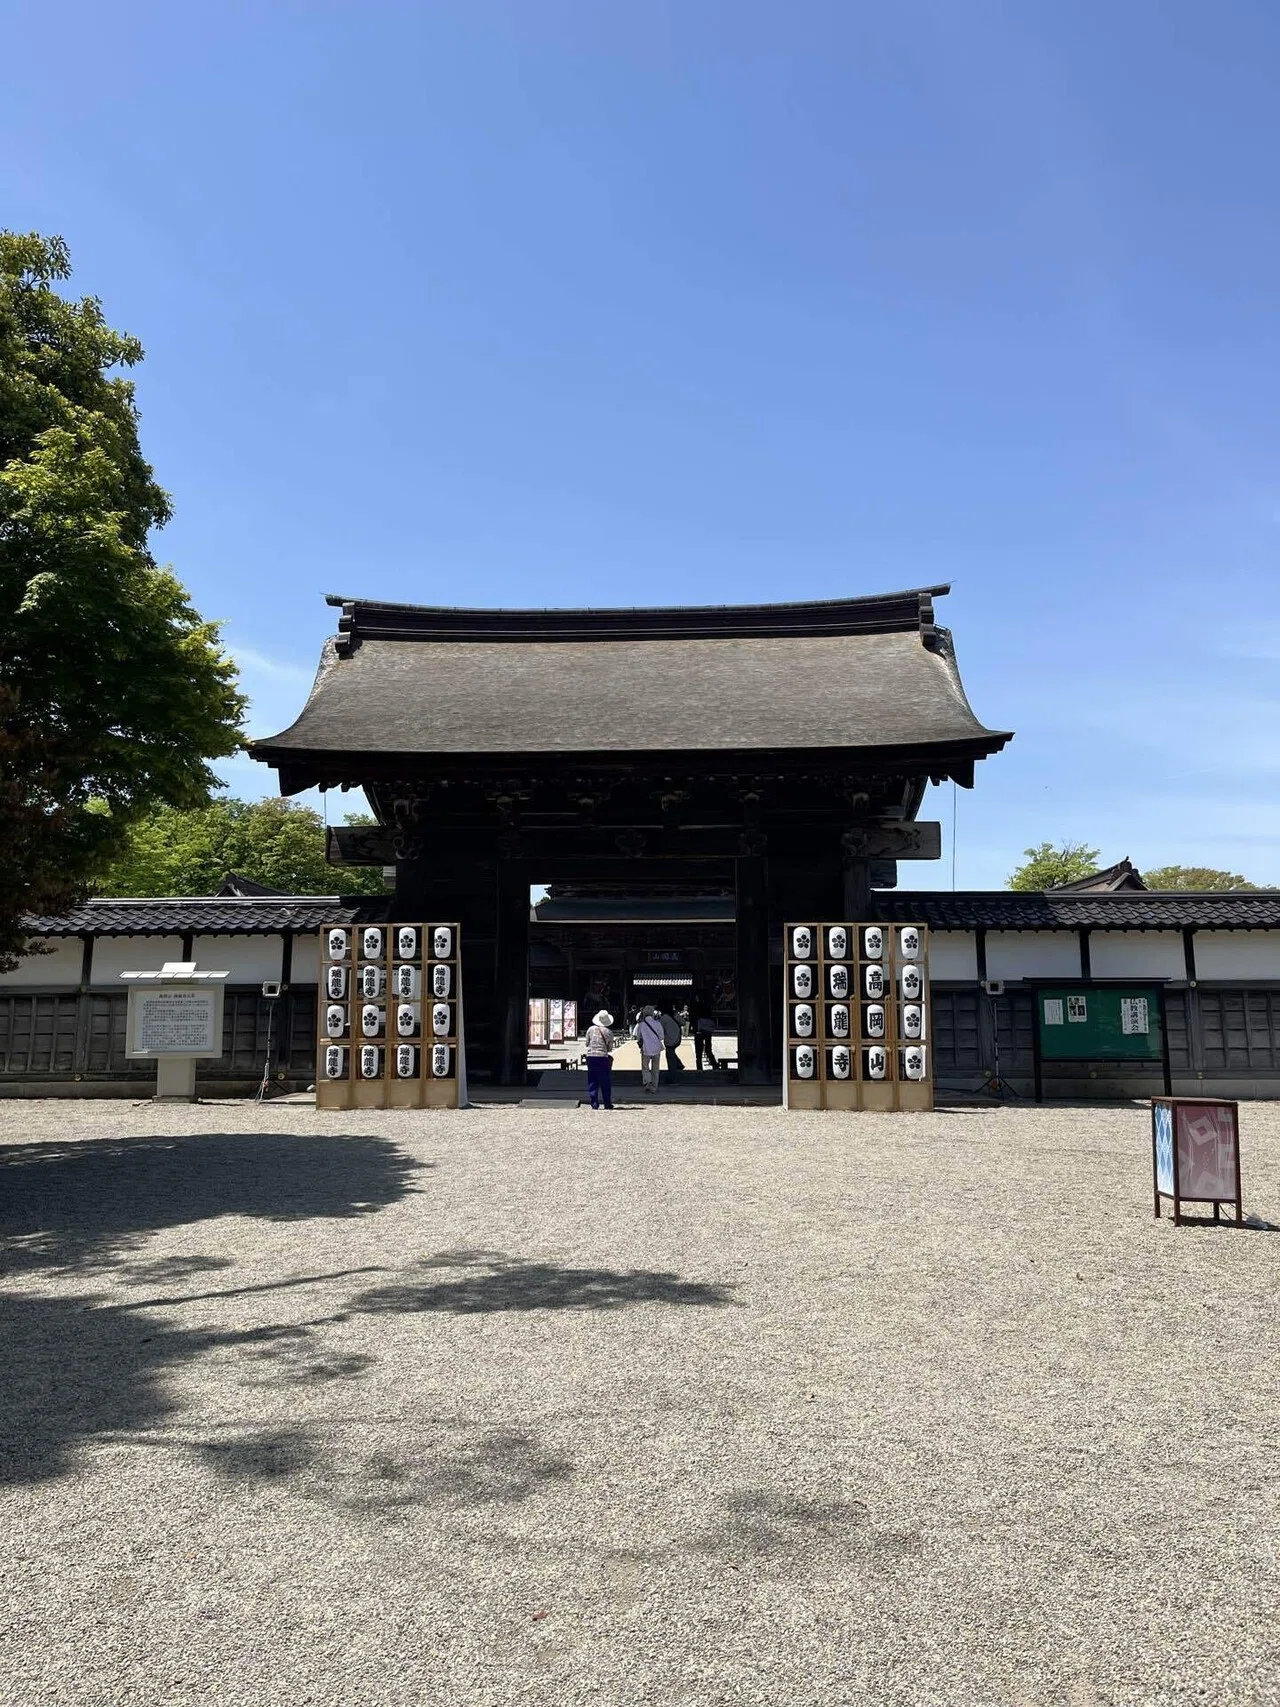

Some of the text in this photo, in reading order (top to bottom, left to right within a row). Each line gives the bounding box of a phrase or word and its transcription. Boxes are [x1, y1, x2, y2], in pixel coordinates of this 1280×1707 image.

[832, 971, 848, 1072] 瑞龍寺
[869, 971, 884, 1071] 高岡山
